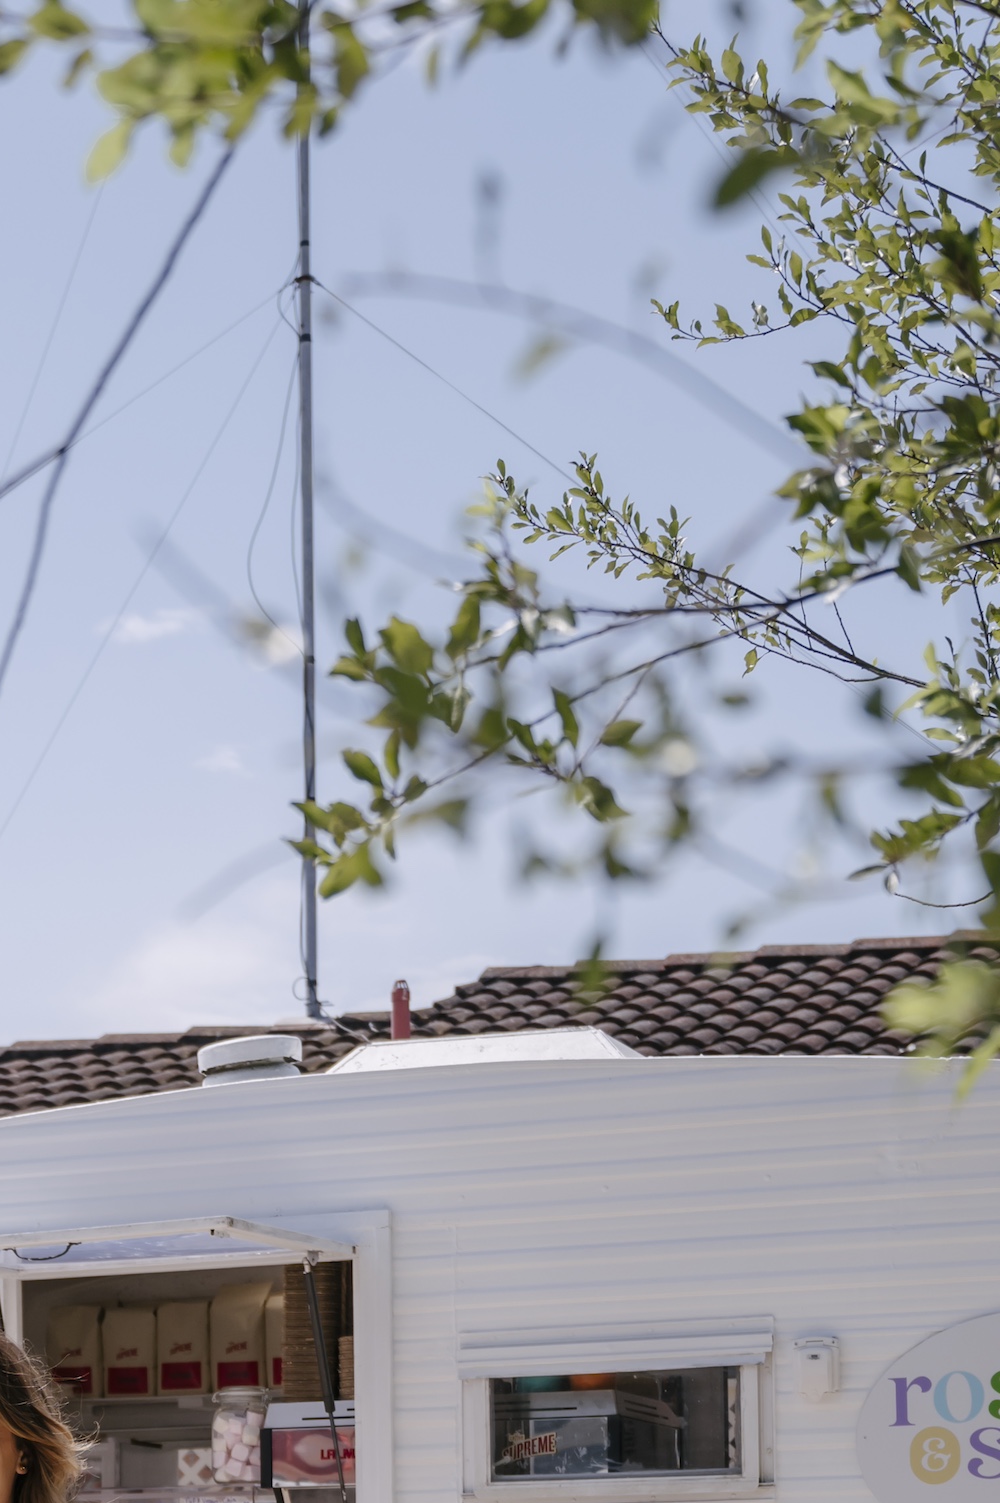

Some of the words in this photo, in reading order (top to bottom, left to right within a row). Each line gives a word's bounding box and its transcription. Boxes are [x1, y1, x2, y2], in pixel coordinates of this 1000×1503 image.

[888, 1370, 1000, 1427] ro
[502, 1433, 556, 1461] SUPREME
[921, 1437, 951, 1472] &
